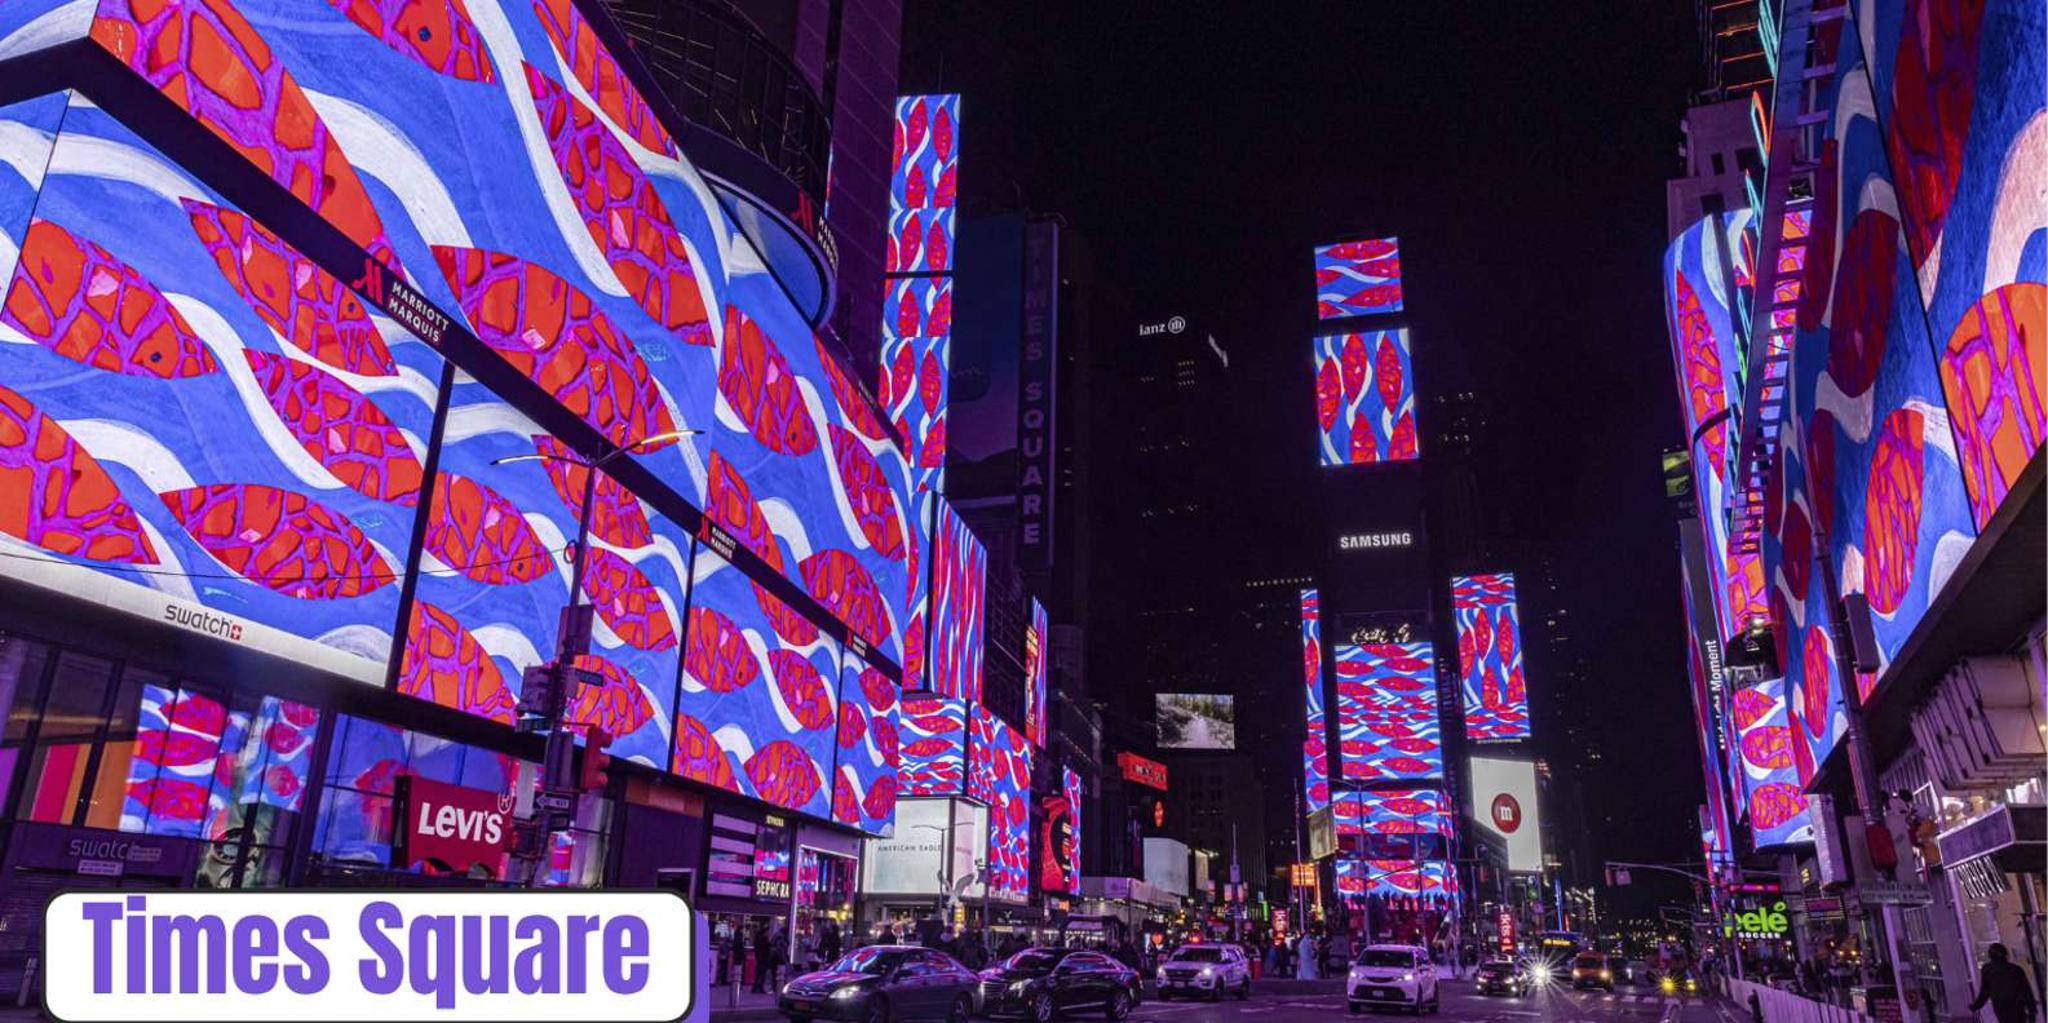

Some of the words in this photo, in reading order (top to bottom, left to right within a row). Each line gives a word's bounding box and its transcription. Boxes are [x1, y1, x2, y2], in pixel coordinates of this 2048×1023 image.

[389, 298, 441, 342] MARQUIS
[392, 282, 449, 332] MARRIOTT
[1022, 381, 1045, 546] SQUARE
[1339, 532, 1412, 549] SAMSUNG
[165, 603, 231, 638] swatch
[1705, 639, 1723, 692] Moment
[1499, 805, 1514, 822] m
[877, 844, 917, 852] AMERICAN
[756, 879, 790, 898] SEPHORA
